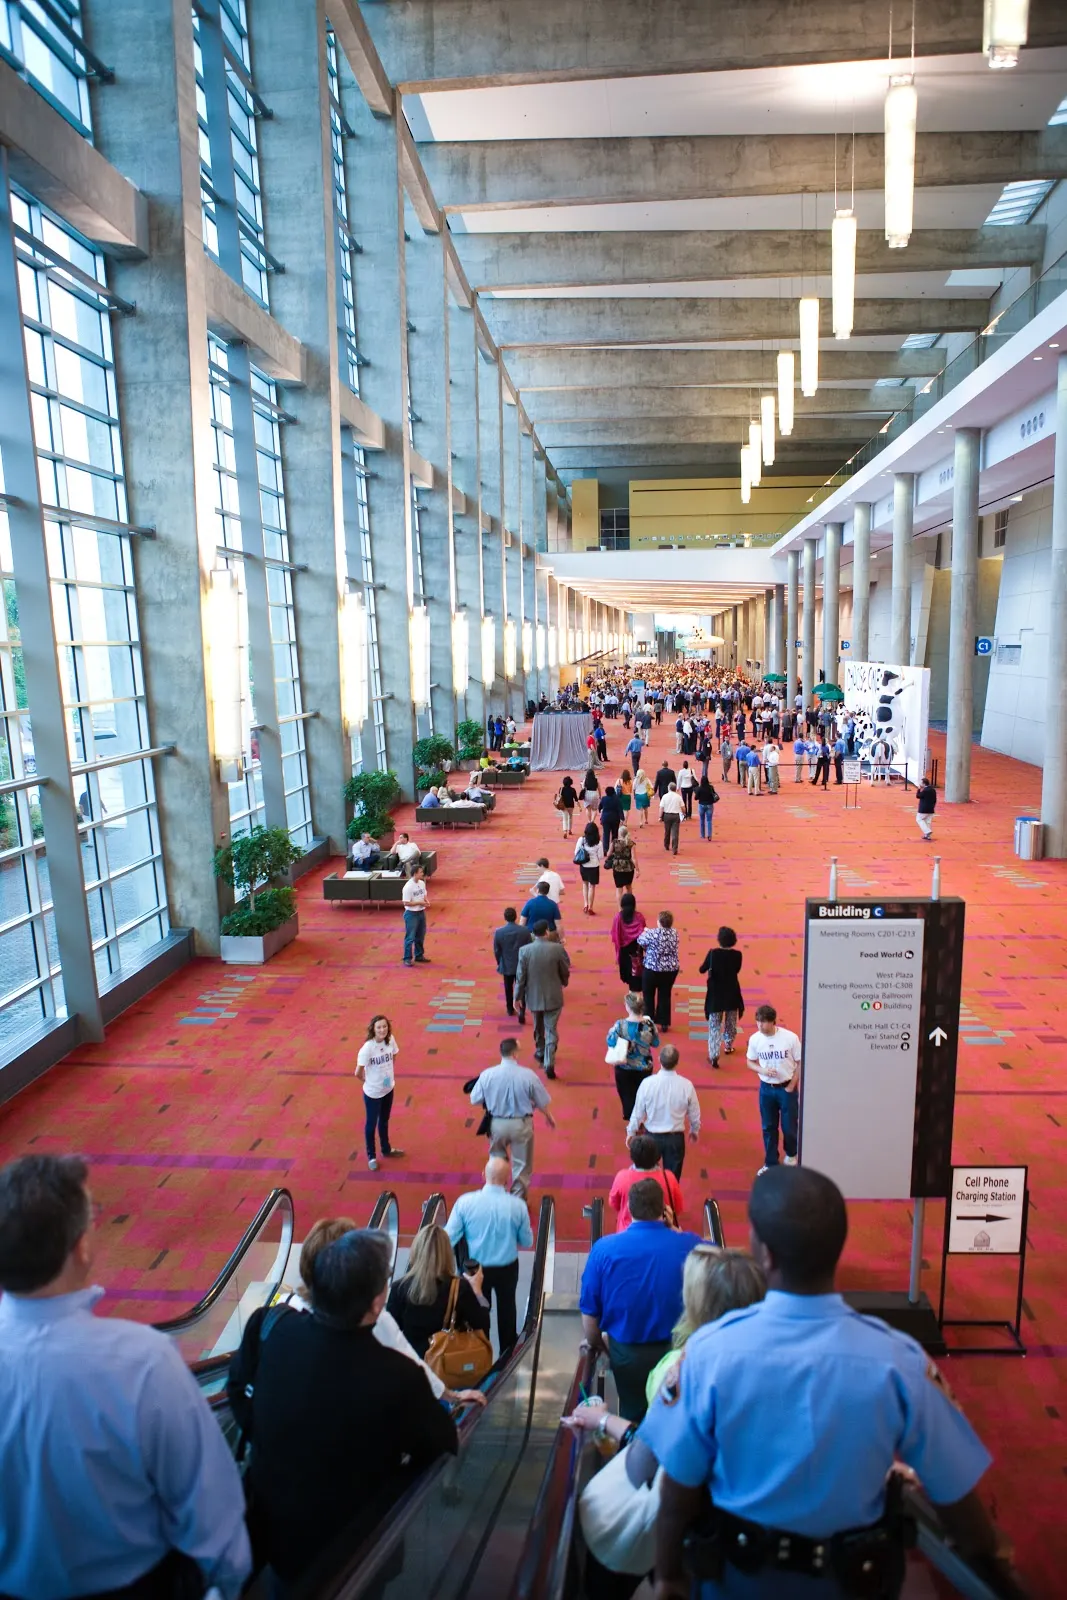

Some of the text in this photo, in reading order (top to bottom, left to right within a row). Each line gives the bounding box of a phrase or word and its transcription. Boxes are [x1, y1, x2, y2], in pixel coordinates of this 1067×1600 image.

[818, 906, 882, 918] Building C
[820, 930, 849, 938] Meeting
[852, 992, 880, 1000] Georgia
[884, 1002, 912, 1011] Building
[966, 1176, 1009, 1188] Cell Phone
[956, 1191, 1016, 1202] Charging Station
